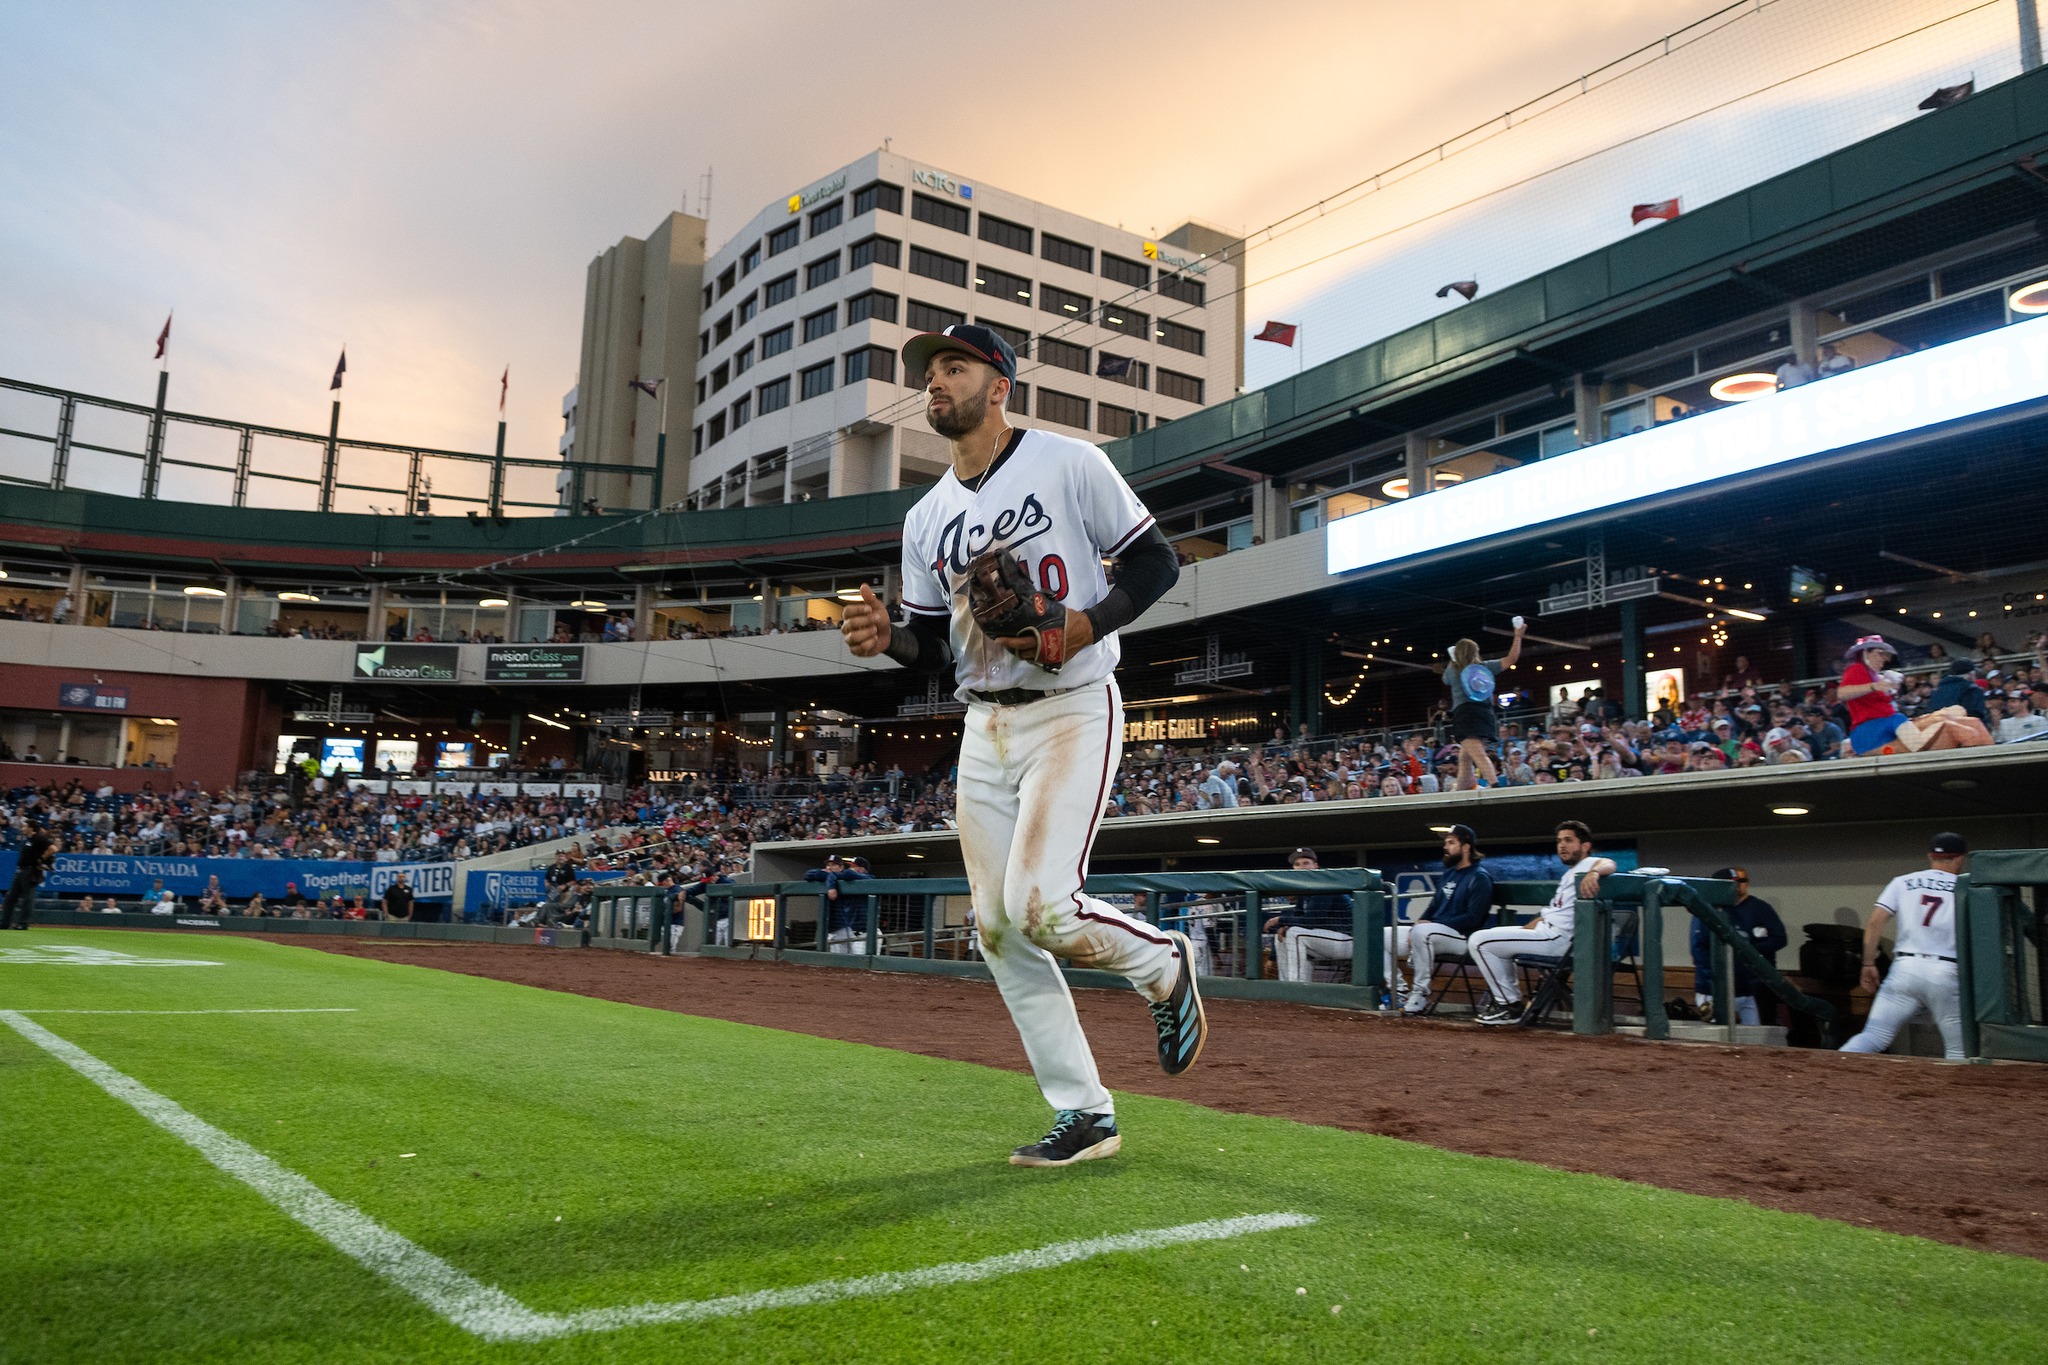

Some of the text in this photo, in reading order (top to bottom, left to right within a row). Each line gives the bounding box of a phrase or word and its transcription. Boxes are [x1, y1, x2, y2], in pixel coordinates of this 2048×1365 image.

[1925, 346, 2013, 409] FOR
[931, 493, 1052, 606] Aces
[1130, 720, 1166, 742] PLATE
[1168, 718, 1206, 739] GRILL
[52, 857, 199, 877] GREATER NEVADA
[50, 874, 131, 888] Credit Union
[502, 874, 538, 886] GREATER
[1919, 894, 1944, 927] 7
